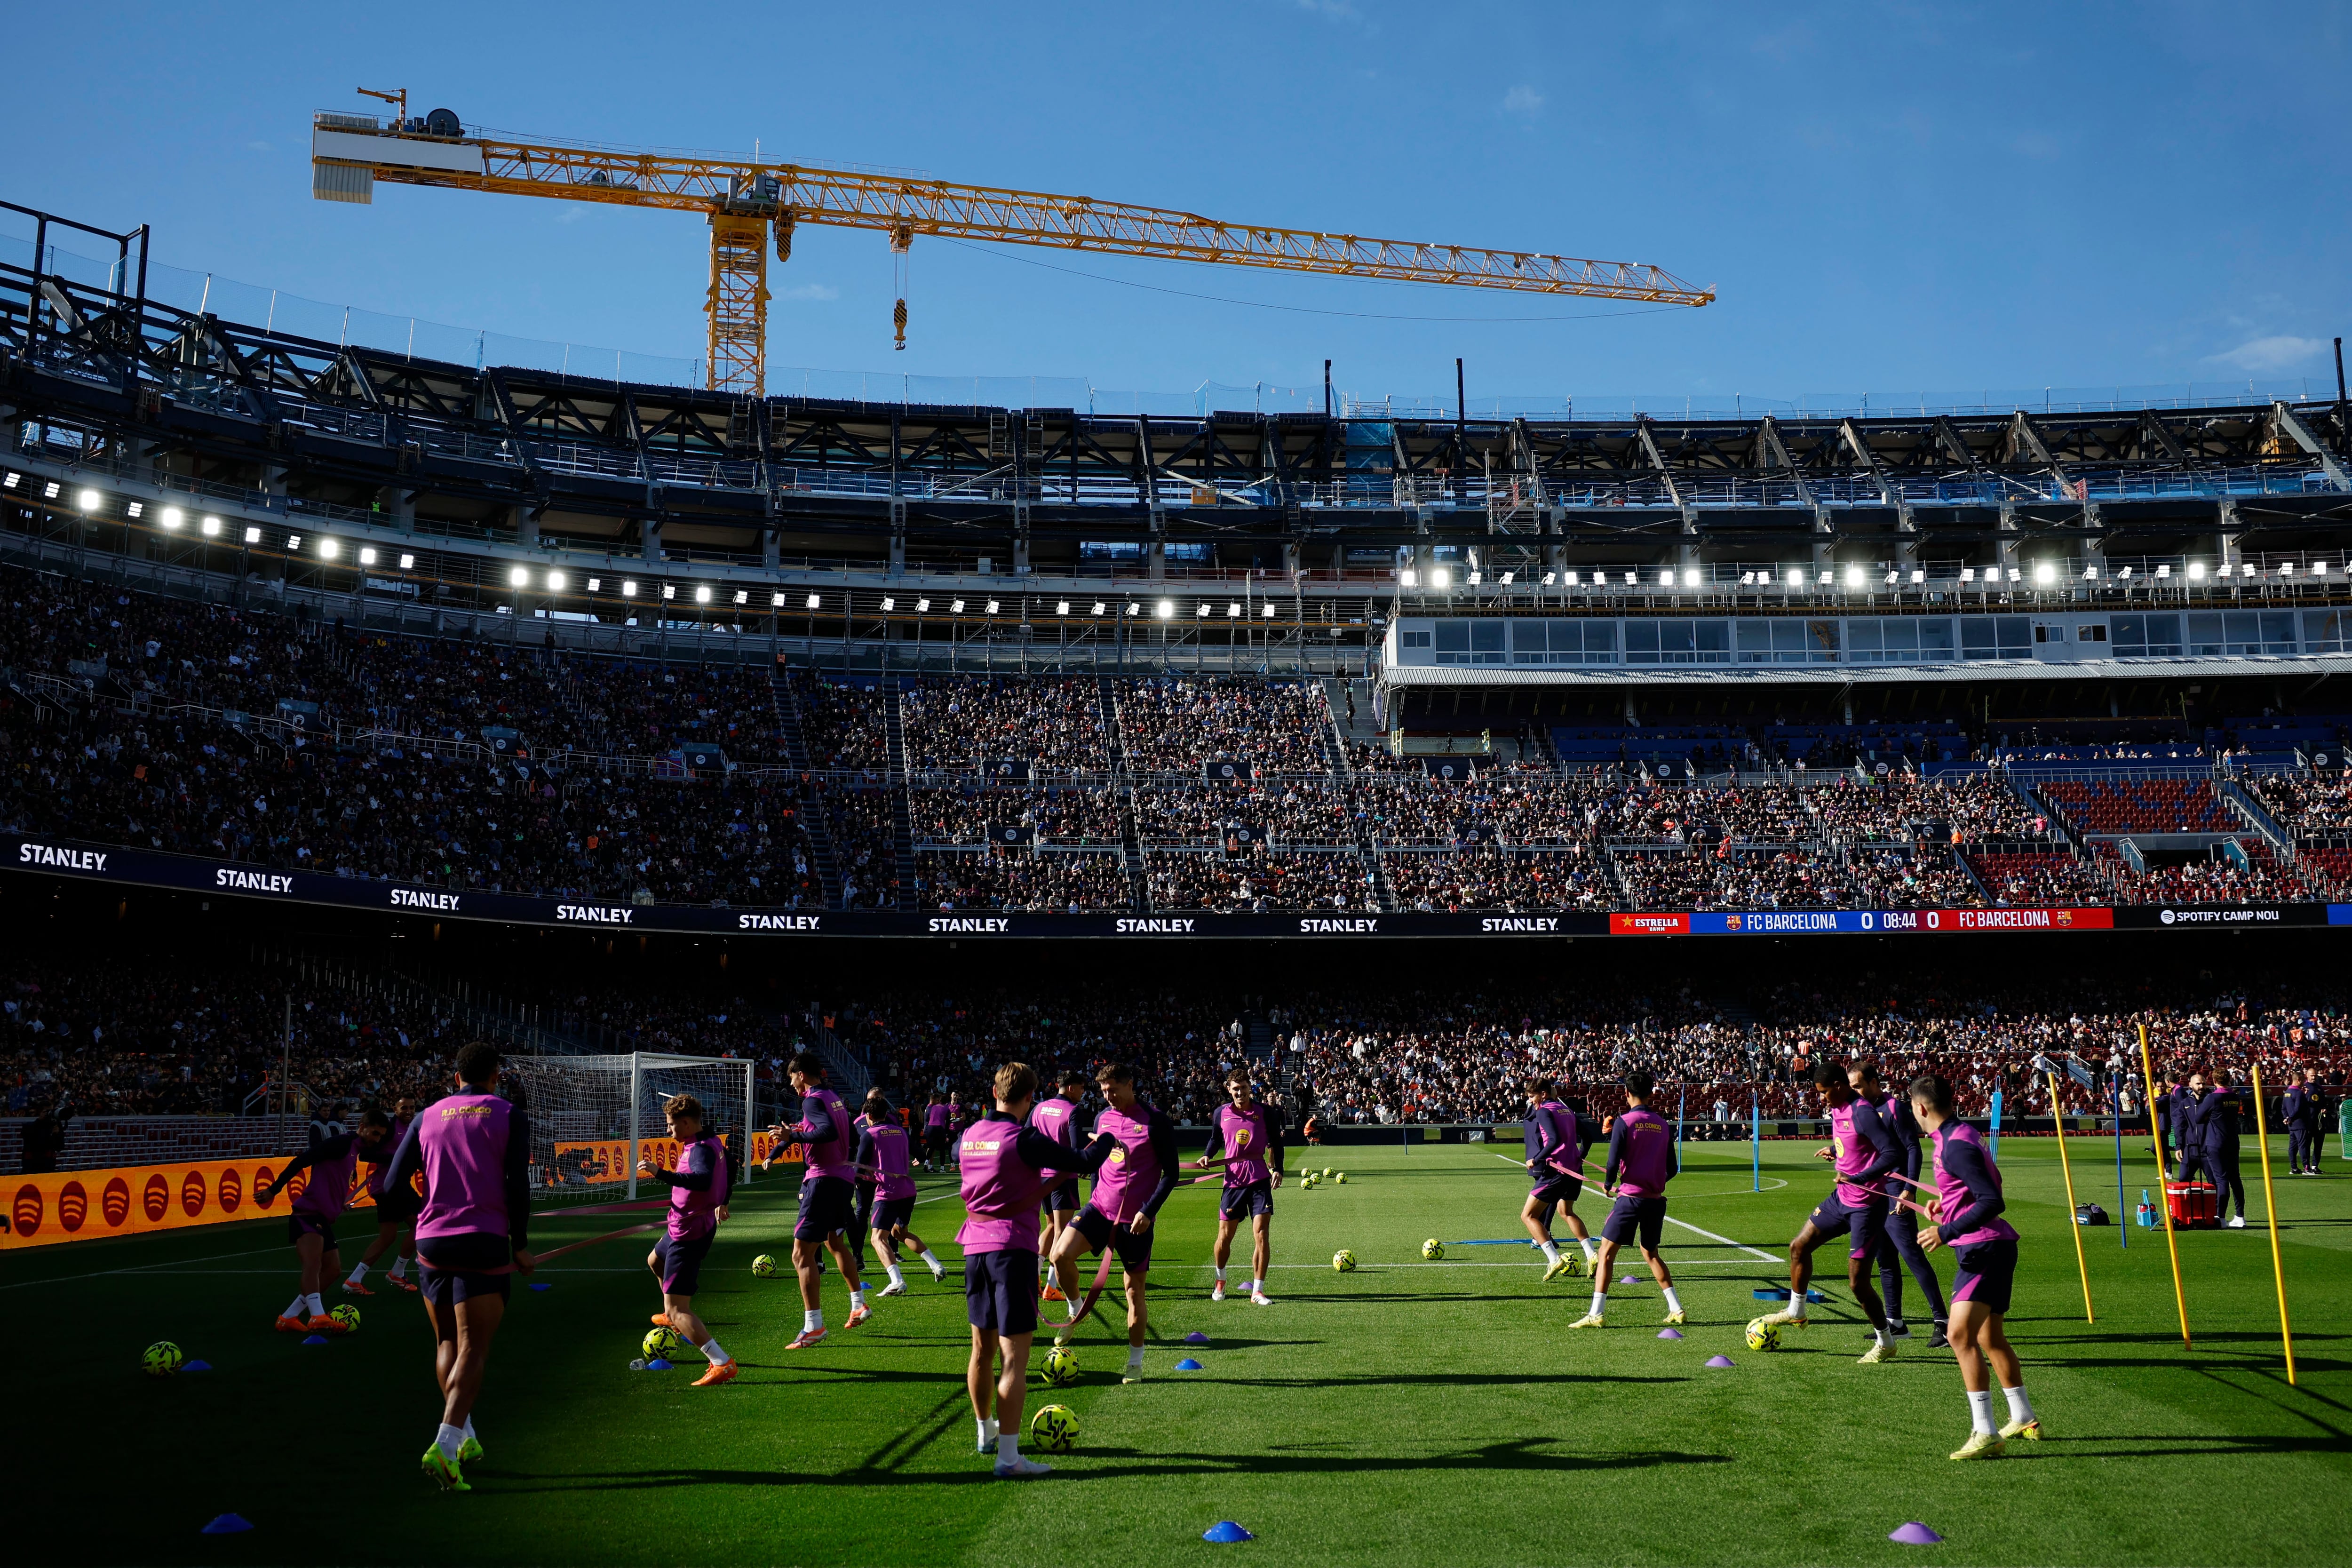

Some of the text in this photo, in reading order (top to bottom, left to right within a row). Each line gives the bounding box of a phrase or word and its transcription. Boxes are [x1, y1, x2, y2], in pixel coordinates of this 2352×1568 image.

[1748, 911, 2050, 930] FC BARCELONA 0 08:44 0 FC BARCELONA
[2177, 910, 2279, 922] SPOTIFY CAMP NOU
[1635, 918, 1678, 927] ESTRELLA
[441, 1107, 457, 1117] R.D.
[975, 1141, 1000, 1150] CONGO
